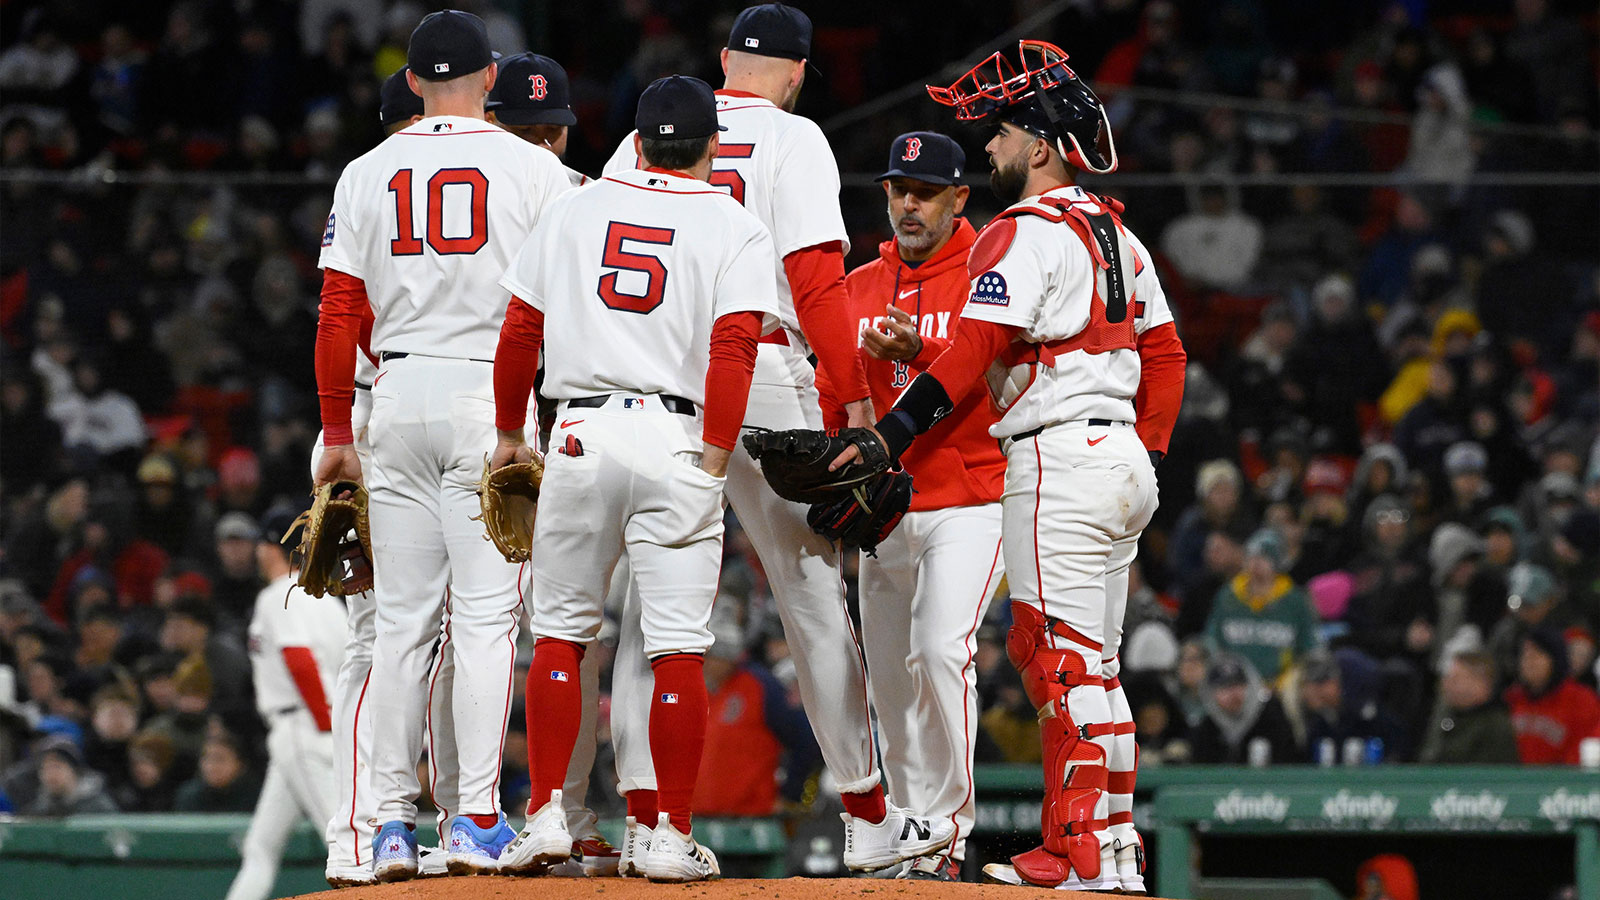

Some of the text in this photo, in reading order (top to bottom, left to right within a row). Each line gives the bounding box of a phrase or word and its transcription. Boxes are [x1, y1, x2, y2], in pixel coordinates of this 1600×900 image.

[528, 74, 548, 101] B
[902, 137, 922, 161] B
[388, 167, 490, 256] 10
[597, 220, 676, 315] 5
[971, 294, 1009, 305] MassMutual
[389, 843, 400, 852] 10
[452, 838, 461, 847] 10
